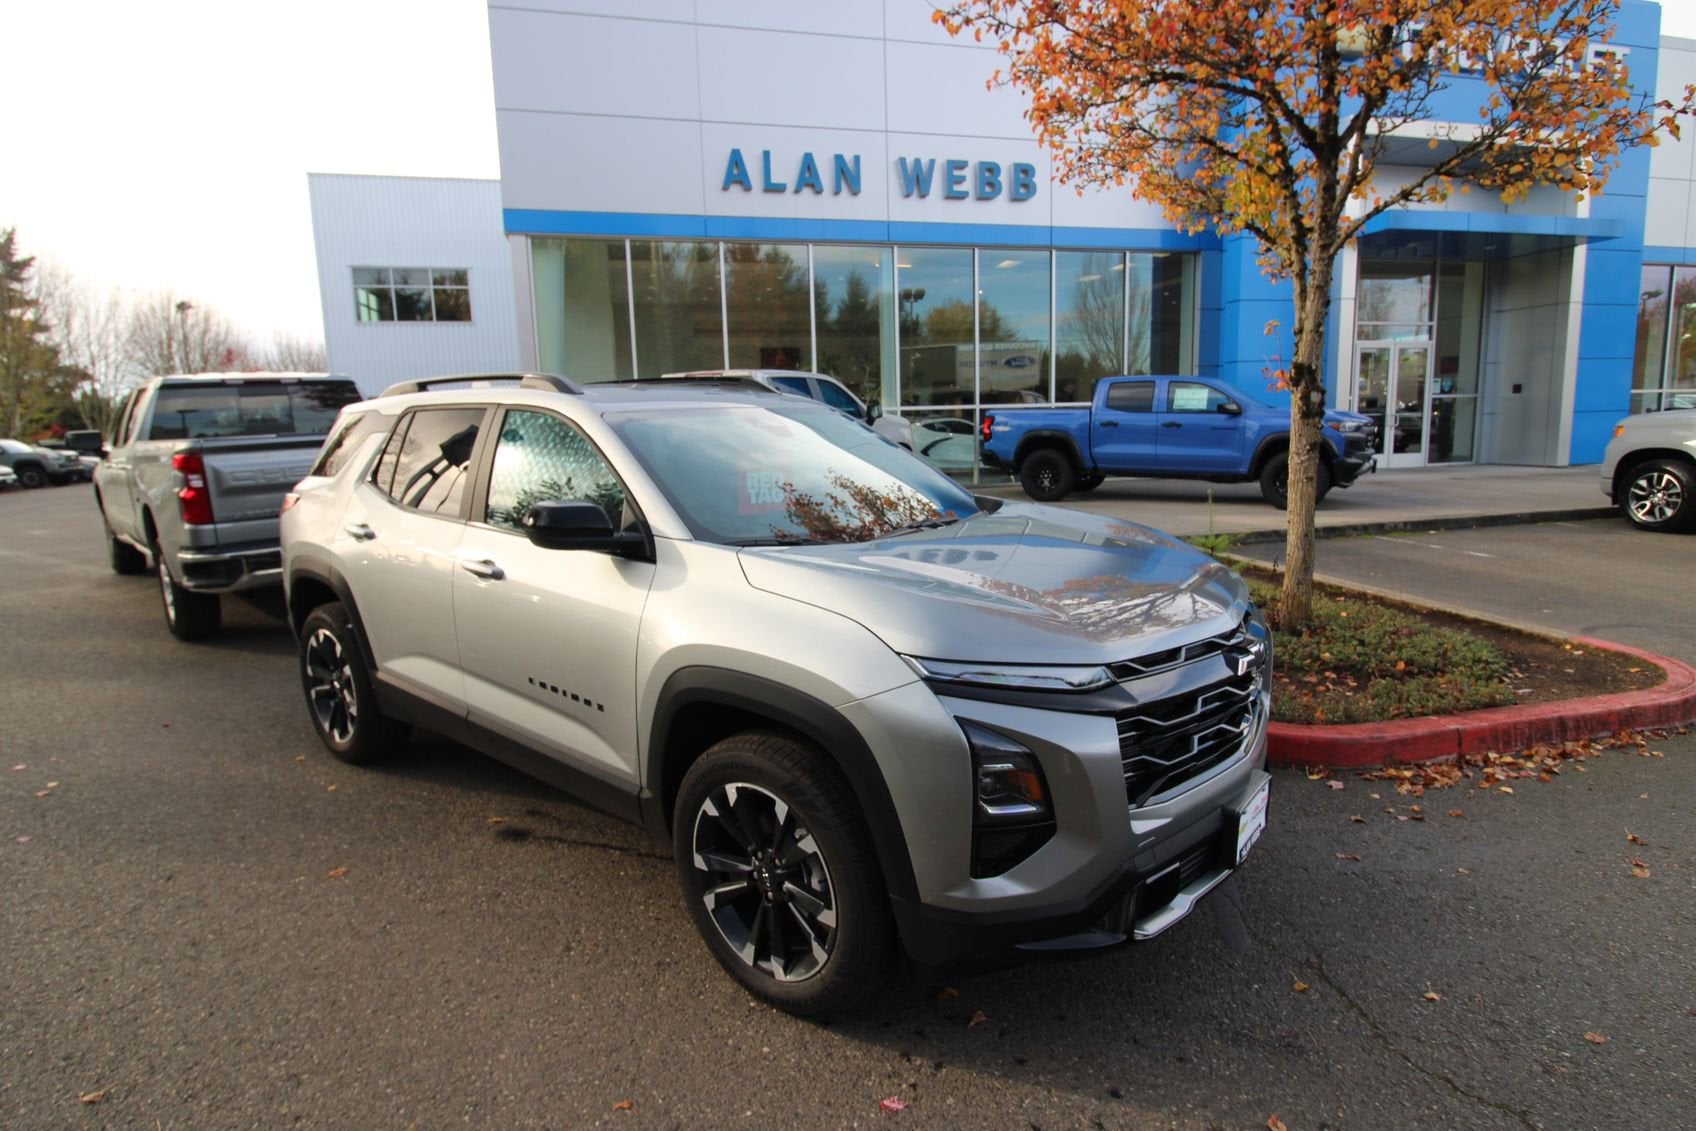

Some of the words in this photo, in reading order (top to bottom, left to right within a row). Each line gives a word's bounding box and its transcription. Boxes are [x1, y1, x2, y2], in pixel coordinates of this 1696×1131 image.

[722, 148, 861, 195] ALAN
[898, 156, 1038, 202] WEBB
[746, 472, 785, 488] RED
[747, 487, 785, 504] TAG
